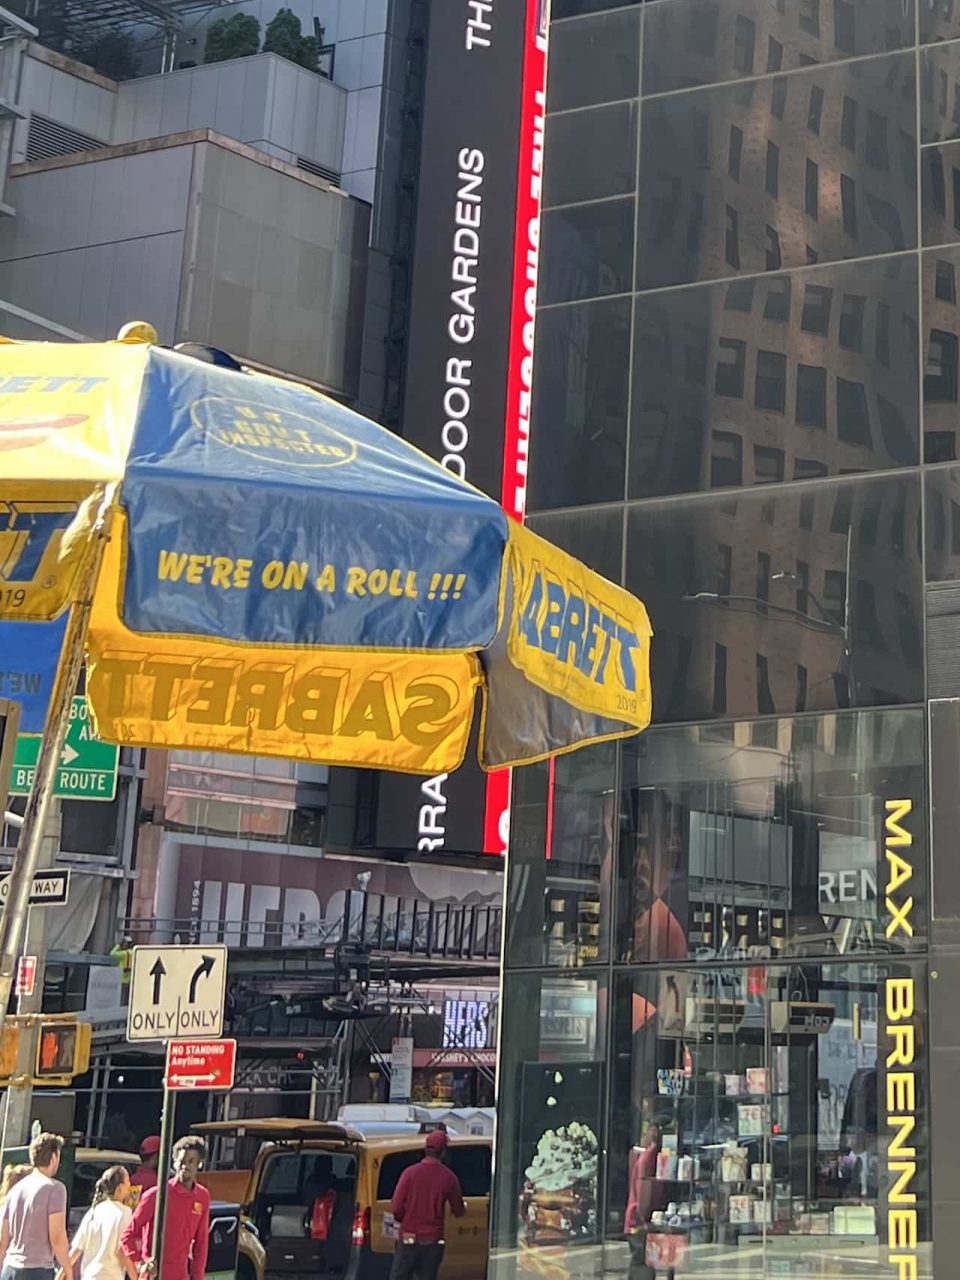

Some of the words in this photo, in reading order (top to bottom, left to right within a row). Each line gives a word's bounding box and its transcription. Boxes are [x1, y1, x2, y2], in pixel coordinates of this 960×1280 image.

[447, 147, 485, 345] GARDENS
[0, 376, 109, 393] ETT
[158, 549, 253, 589] WE'RE
[261, 560, 309, 591] ON
[315, 563, 336, 593] A
[346, 565, 418, 598] ROLL
[427, 573, 466, 600] !!!
[521, 564, 641, 693] ABRETT
[17, 770, 35, 786] BE
[60, 772, 106, 790] ROUTE
[885, 799, 913, 939] MAX
[35, 881, 60, 895] WAY
[133, 1011, 175, 1030] ONLY
[180, 1009, 219, 1028] ONLY
[172, 1045, 184, 1055] NO
[186, 1045, 225, 1055] STANDING
